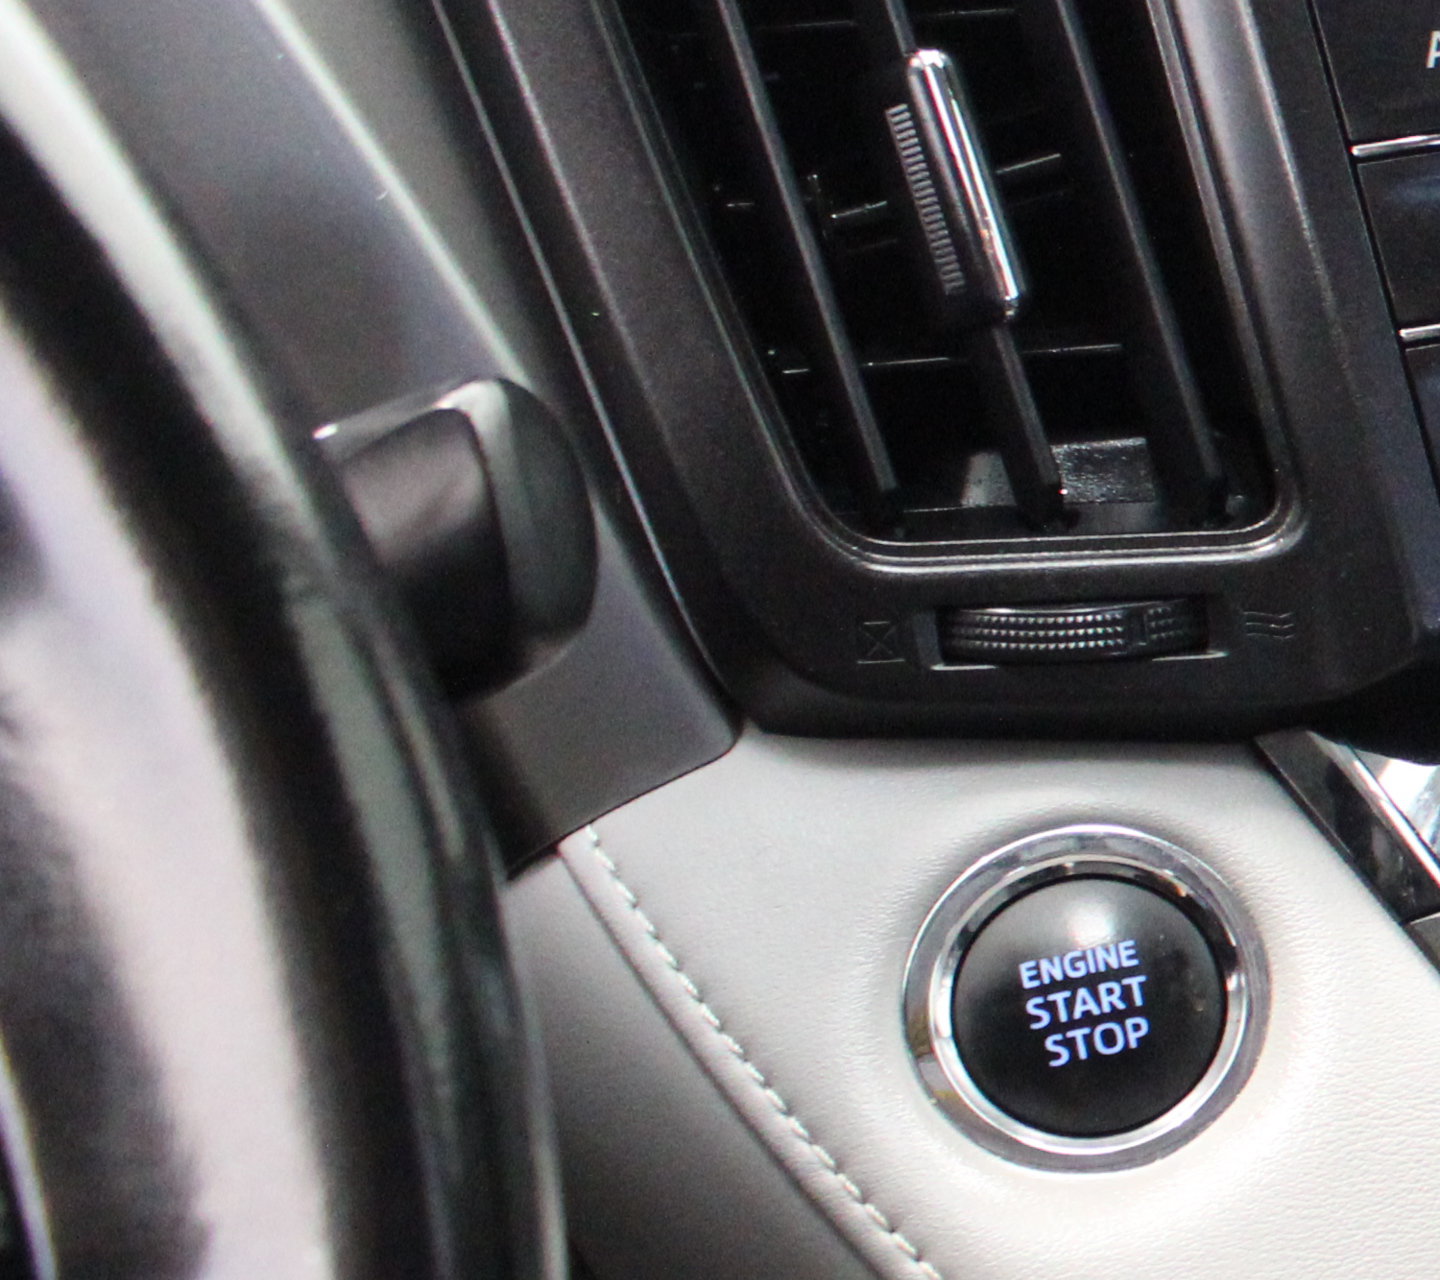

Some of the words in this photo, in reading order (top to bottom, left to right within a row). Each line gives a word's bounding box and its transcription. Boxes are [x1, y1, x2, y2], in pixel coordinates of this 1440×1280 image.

[1018, 939, 1140, 990] ENGINE
[1024, 974, 1147, 1030] START
[1044, 1015, 1150, 1068] STOP
